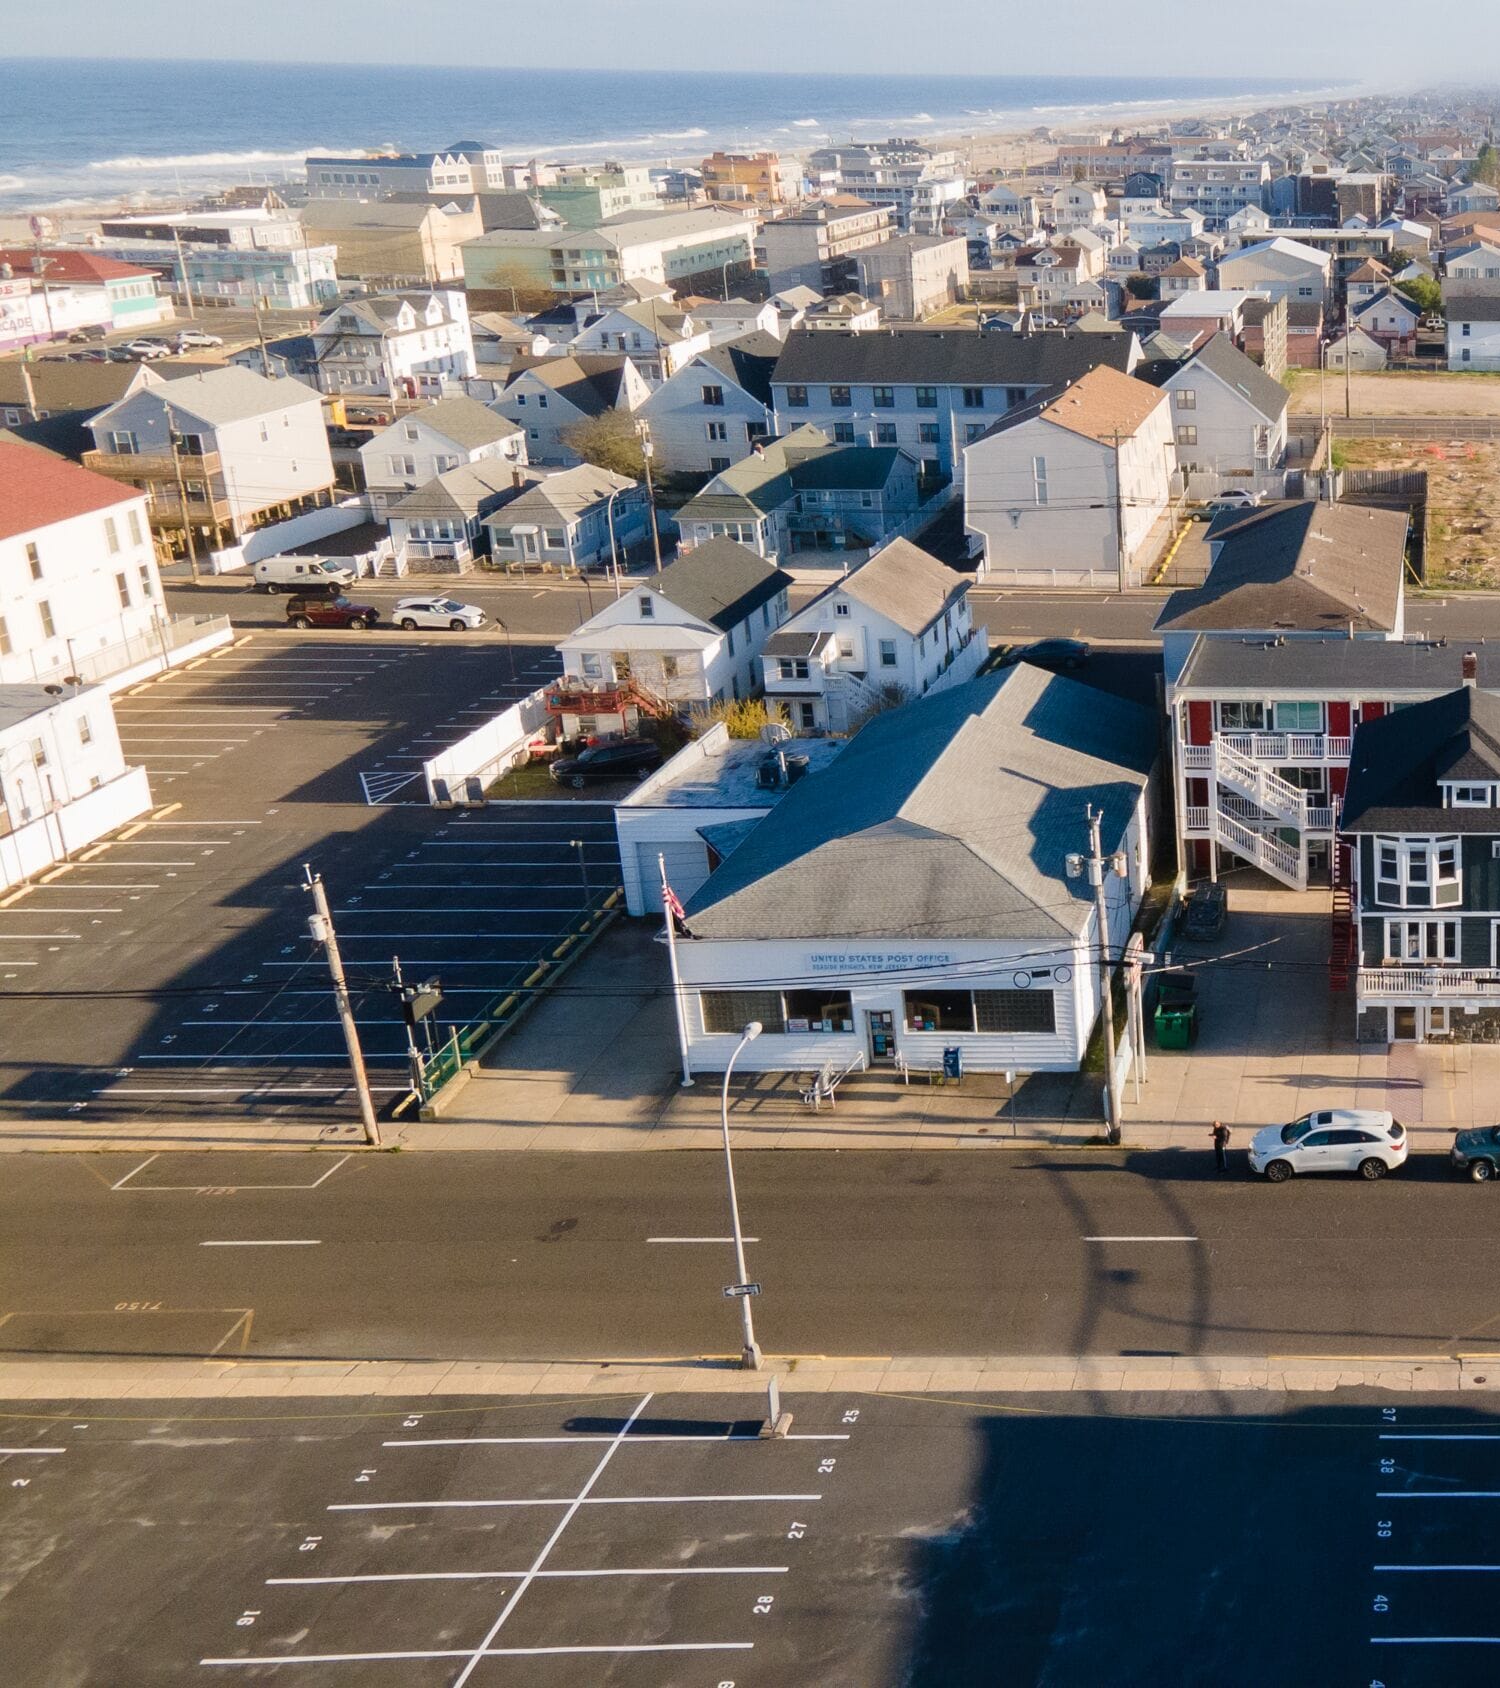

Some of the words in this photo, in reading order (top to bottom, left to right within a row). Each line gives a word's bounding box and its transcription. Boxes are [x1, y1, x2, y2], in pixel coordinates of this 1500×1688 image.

[114, 1301, 162, 1311] 7150
[402, 1414, 424, 1427] 13
[841, 1409, 860, 1423] 25
[1382, 1407, 1396, 1422] 37
[817, 1458, 836, 1473] 26
[1380, 1458, 1395, 1473] 38
[11, 1478, 31, 1487] 2
[354, 1469, 377, 1482] 14
[787, 1521, 807, 1539] 27
[1377, 1520, 1392, 1537] 39
[298, 1536, 323, 1551] 15
[752, 1595, 774, 1614] 28
[1373, 1594, 1389, 1611] 40
[236, 1610, 261, 1626] 16
